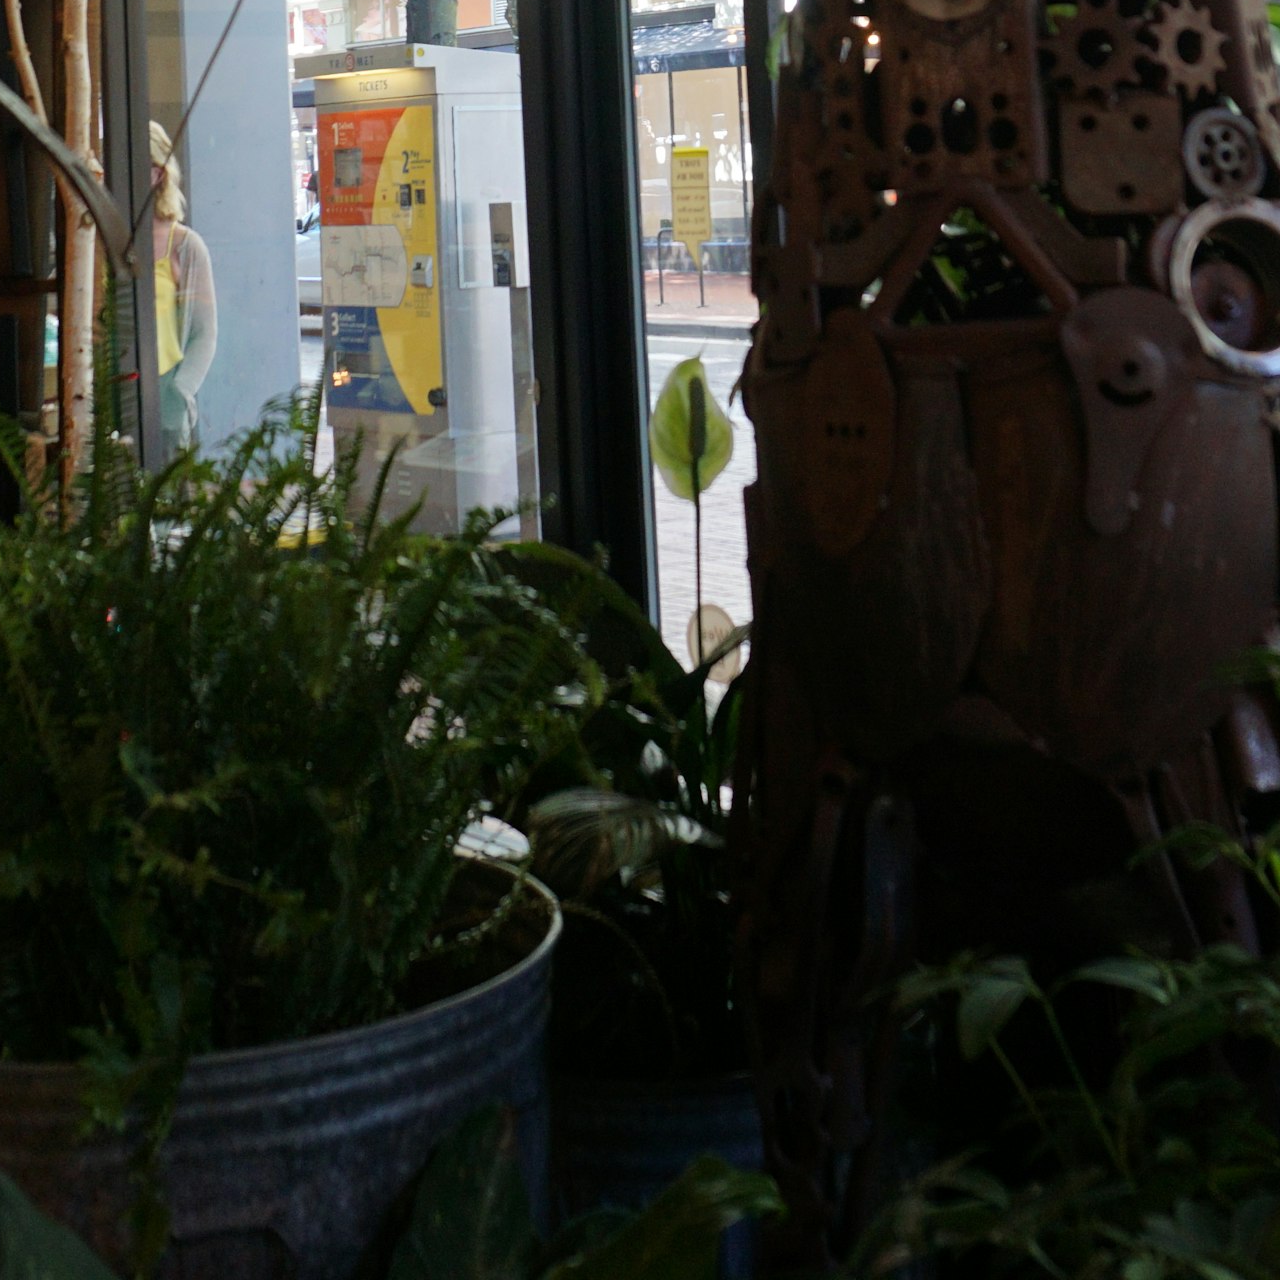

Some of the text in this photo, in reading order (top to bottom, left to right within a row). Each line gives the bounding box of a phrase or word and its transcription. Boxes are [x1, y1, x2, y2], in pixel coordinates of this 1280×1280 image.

[356, 54, 374, 67] MET
[358, 79, 389, 93] TICKETS
[331, 122, 339, 146] 1
[401, 150, 409, 174] 2
[331, 311, 339, 336] 3
